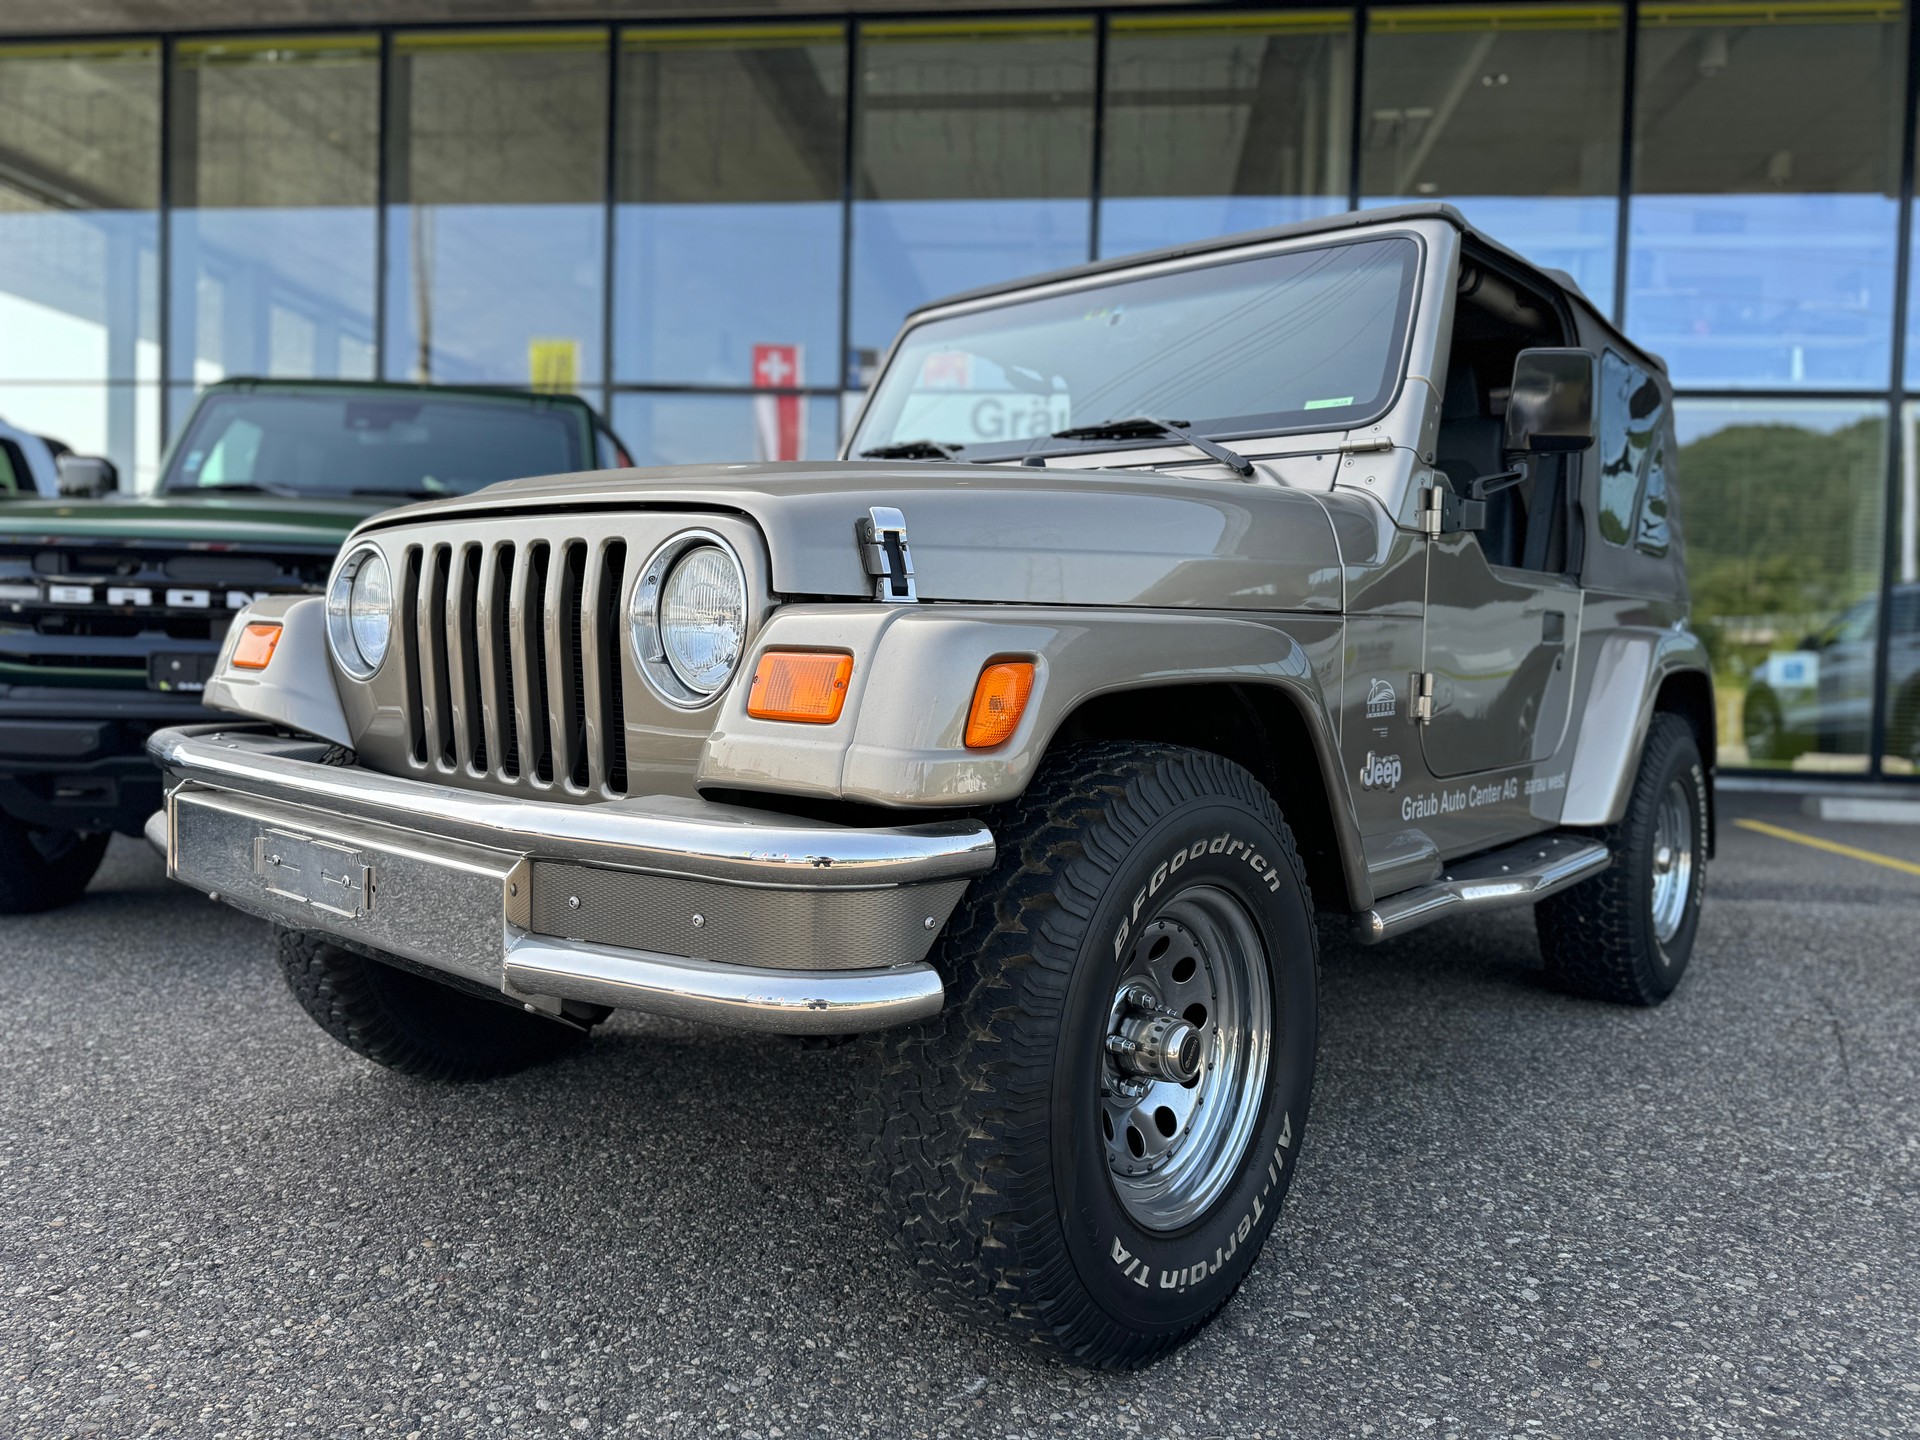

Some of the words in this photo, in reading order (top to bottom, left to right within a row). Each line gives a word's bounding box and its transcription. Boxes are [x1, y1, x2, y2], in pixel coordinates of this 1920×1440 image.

[1361, 752, 1402, 790] Jeep
[1401, 792, 1438, 821] Gräub
[1440, 790, 1466, 814] Auto
[1468, 784, 1501, 807] Center
[1502, 777, 1518, 800] AG
[1113, 831, 1281, 962] BFGoodrich
[1160, 1111, 1292, 1293] All-Terrain
[1110, 1235, 1149, 1288] T/A
